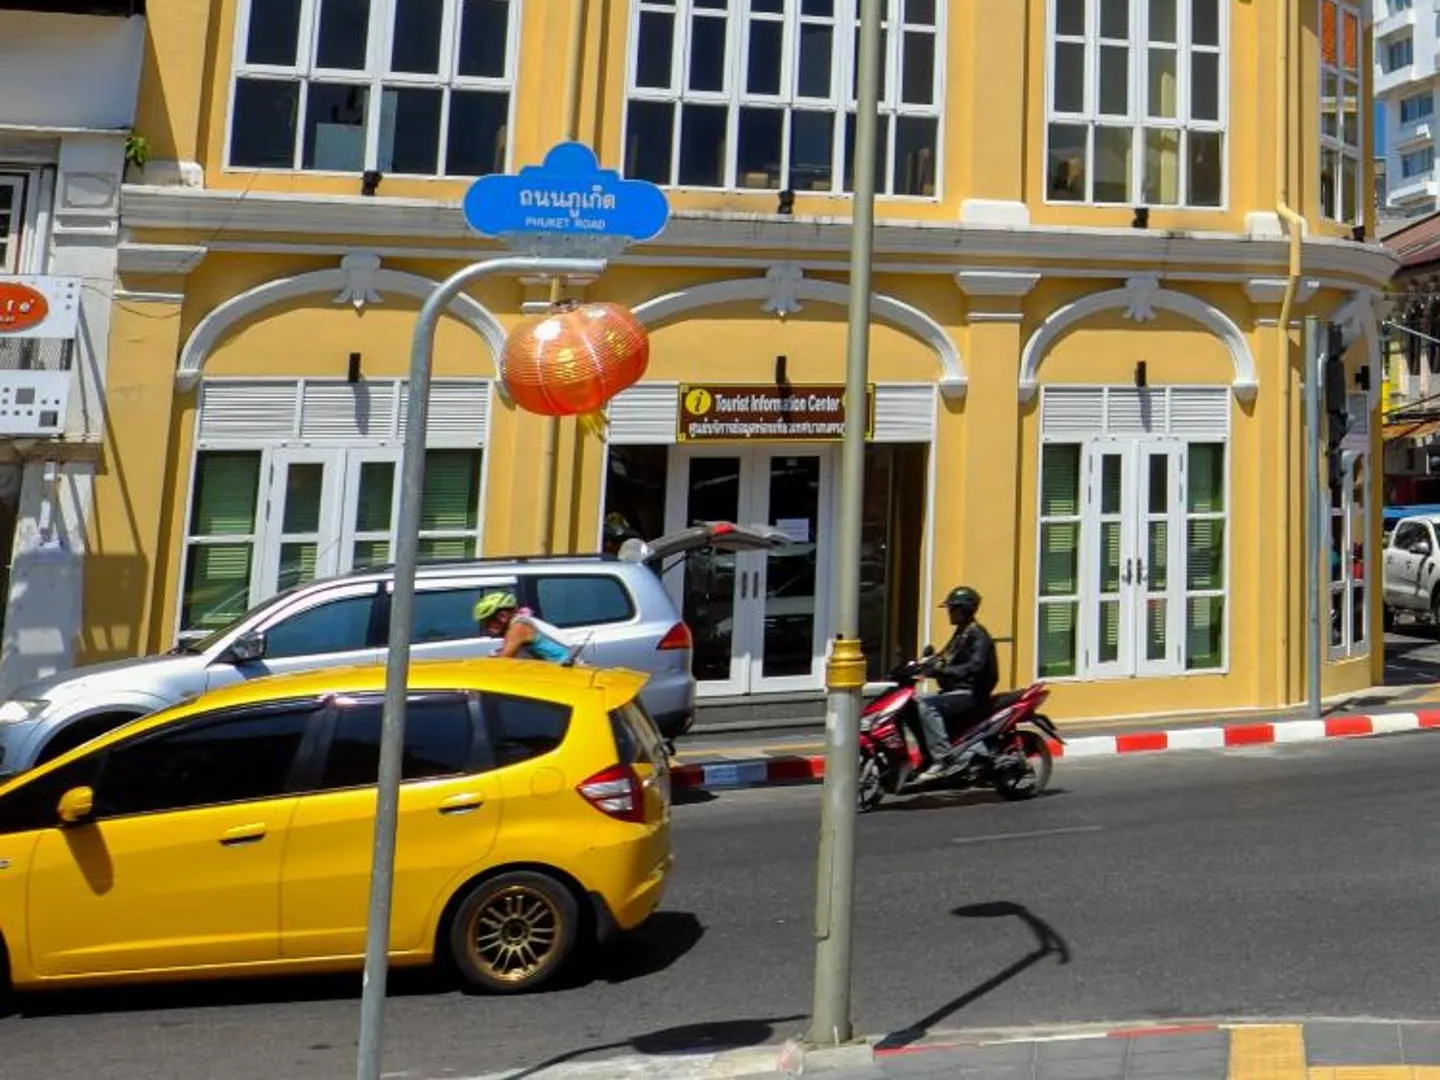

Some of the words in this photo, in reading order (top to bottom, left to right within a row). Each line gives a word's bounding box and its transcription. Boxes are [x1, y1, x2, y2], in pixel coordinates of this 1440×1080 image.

[520, 184, 616, 218] ถนนภูเก็ต
[525, 216, 569, 229] PHUKET
[575, 218, 606, 230] ROAD
[715, 394, 749, 412] Tourist
[808, 394, 840, 412] Center
